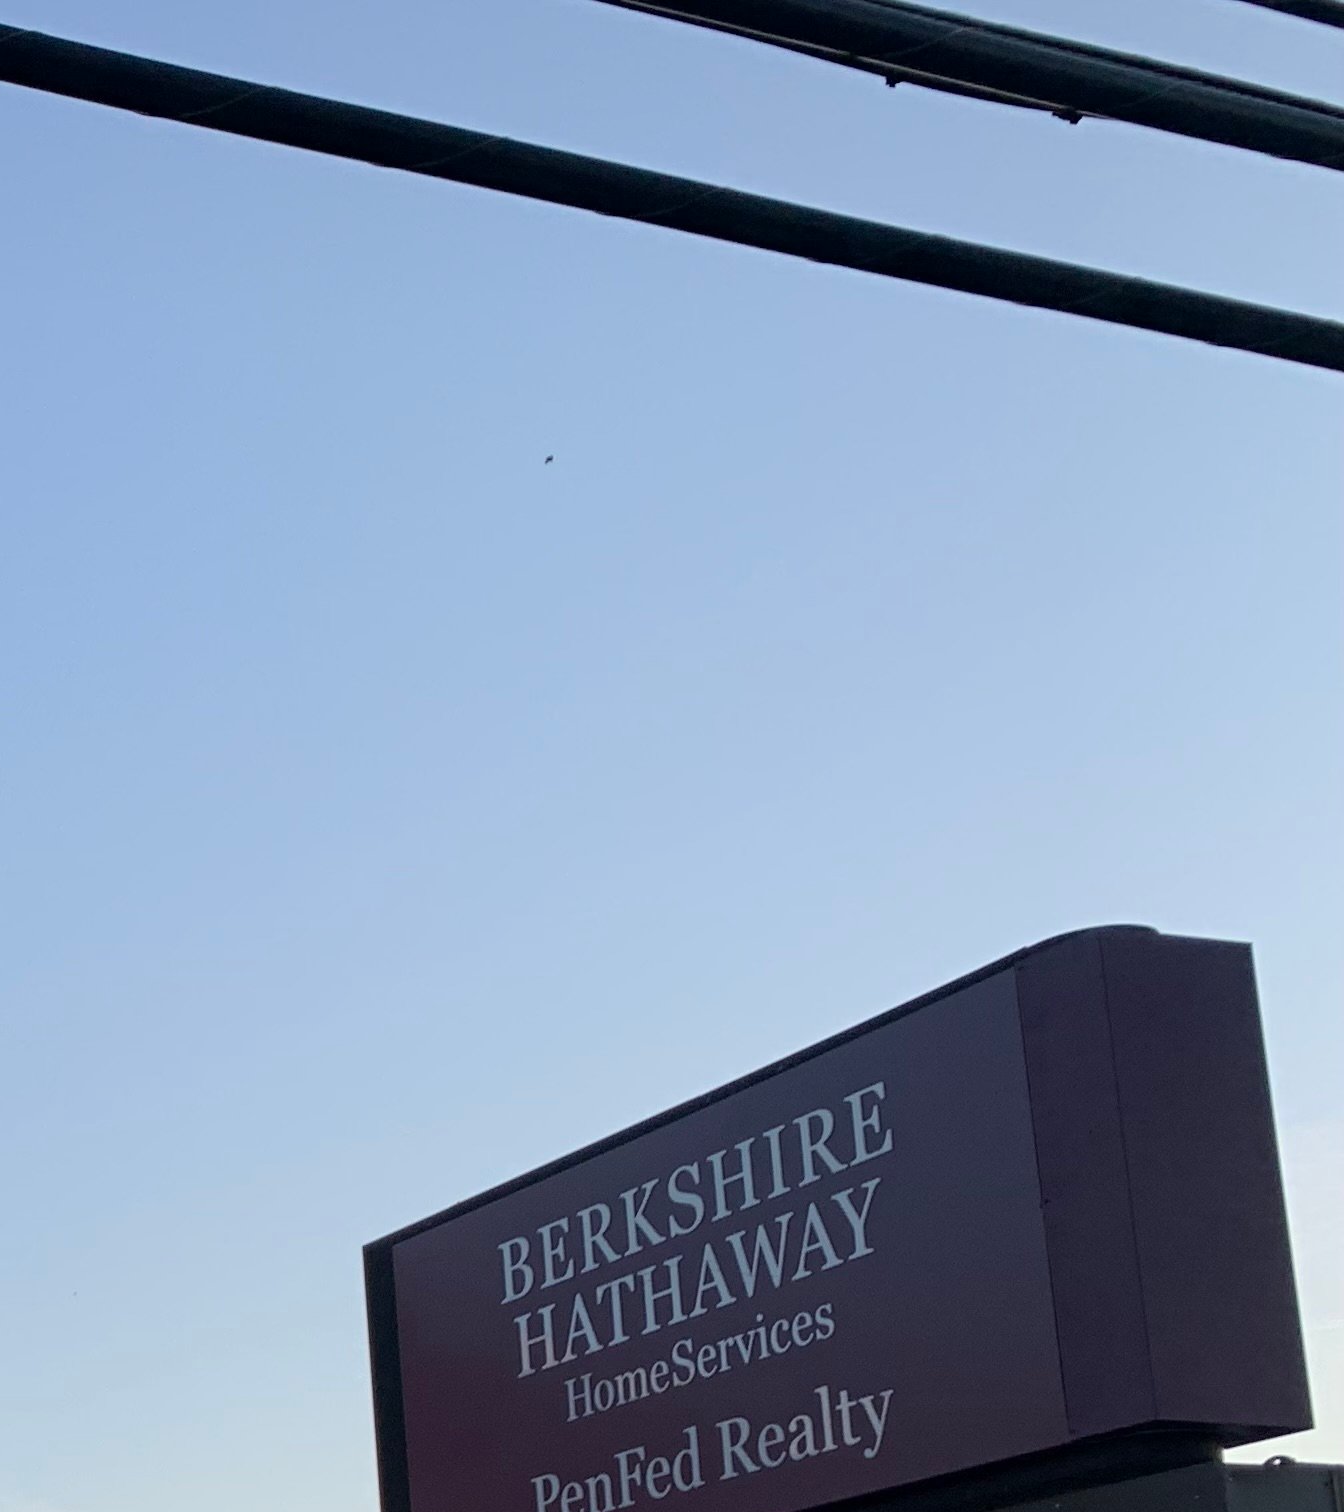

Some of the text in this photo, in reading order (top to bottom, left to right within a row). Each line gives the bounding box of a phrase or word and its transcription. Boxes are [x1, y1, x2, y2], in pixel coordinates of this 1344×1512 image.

[498, 1081, 894, 1305] BERKSHIRE
[513, 1177, 882, 1378] HATHAWAY
[564, 1302, 836, 1422] HomeServices
[715, 1384, 894, 1480] Realty
